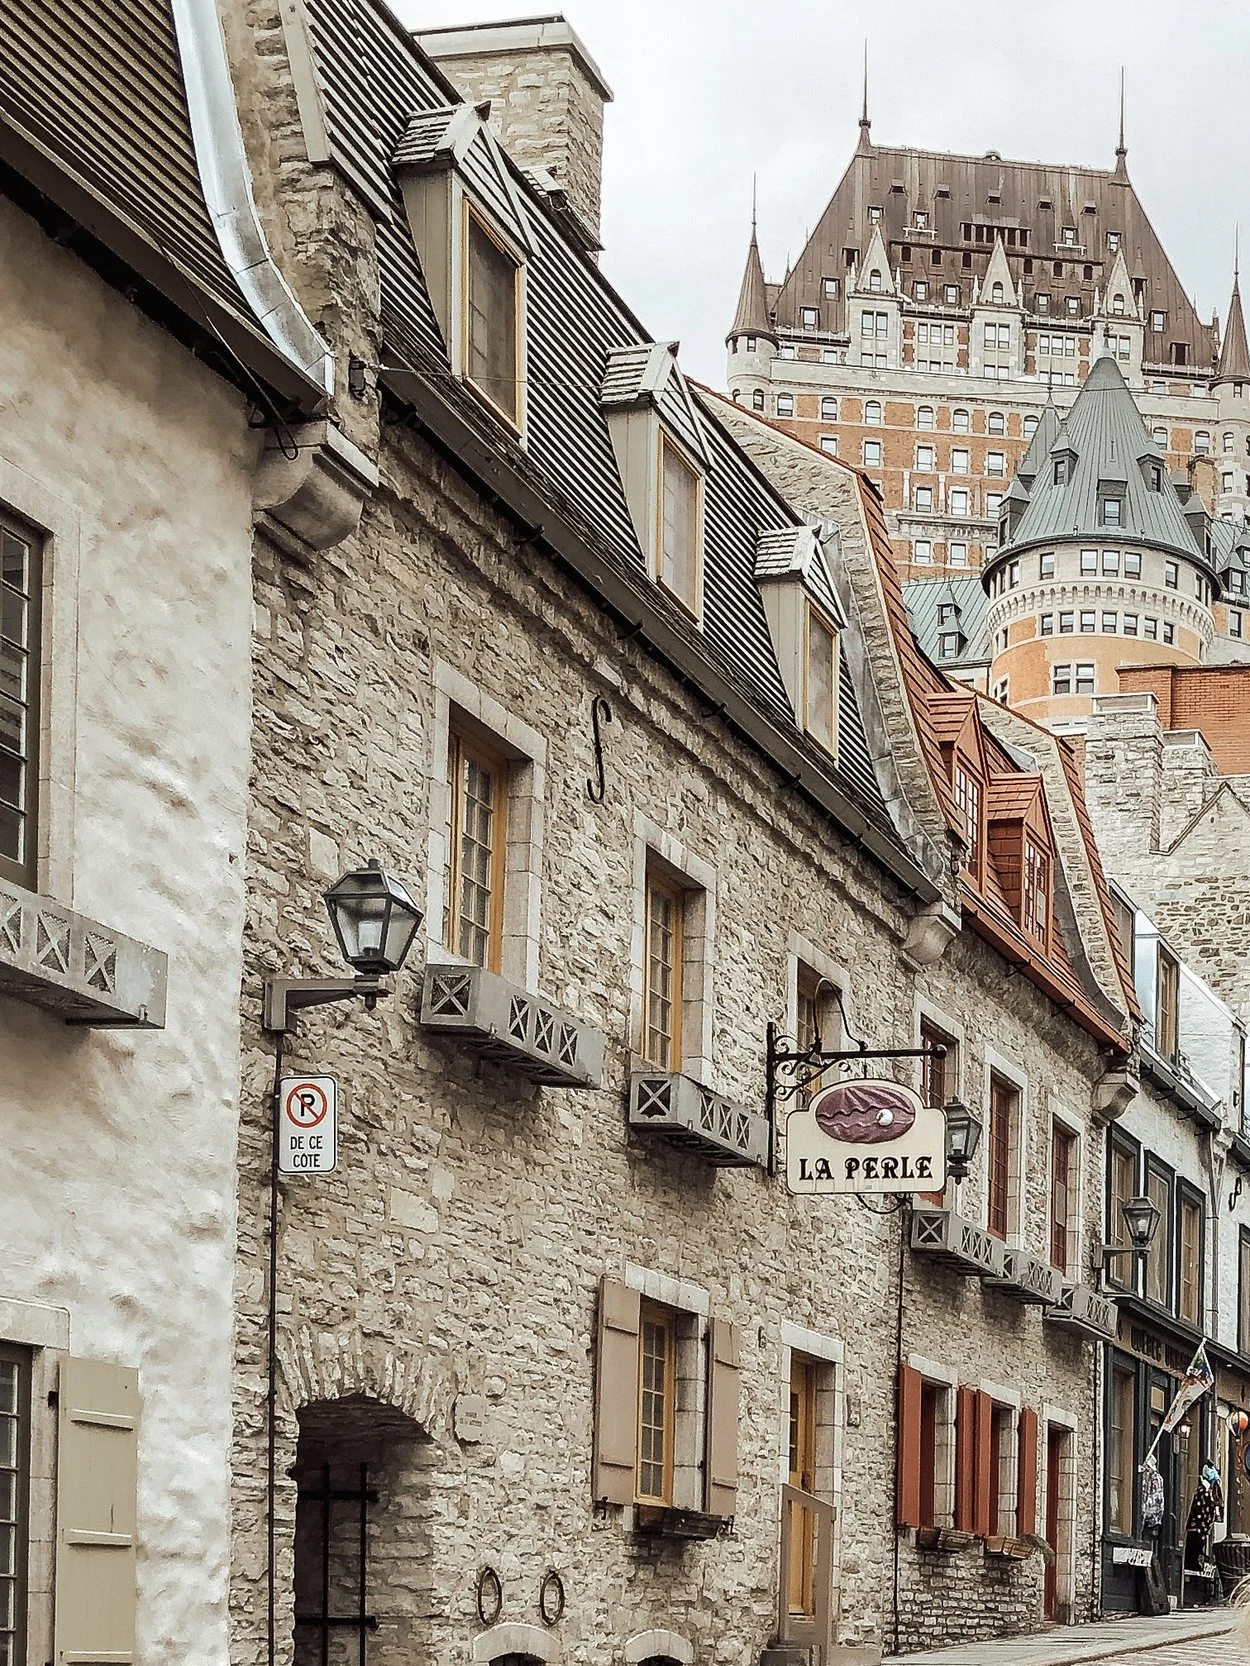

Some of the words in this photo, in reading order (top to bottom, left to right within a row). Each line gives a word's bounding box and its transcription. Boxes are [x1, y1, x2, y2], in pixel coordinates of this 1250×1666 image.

[290, 1136, 304, 1150] DE
[309, 1136, 323, 1149] CE
[293, 1153, 320, 1168] CÔTE
[799, 1158, 834, 1180] LA
[844, 1156, 933, 1180] PERLE
